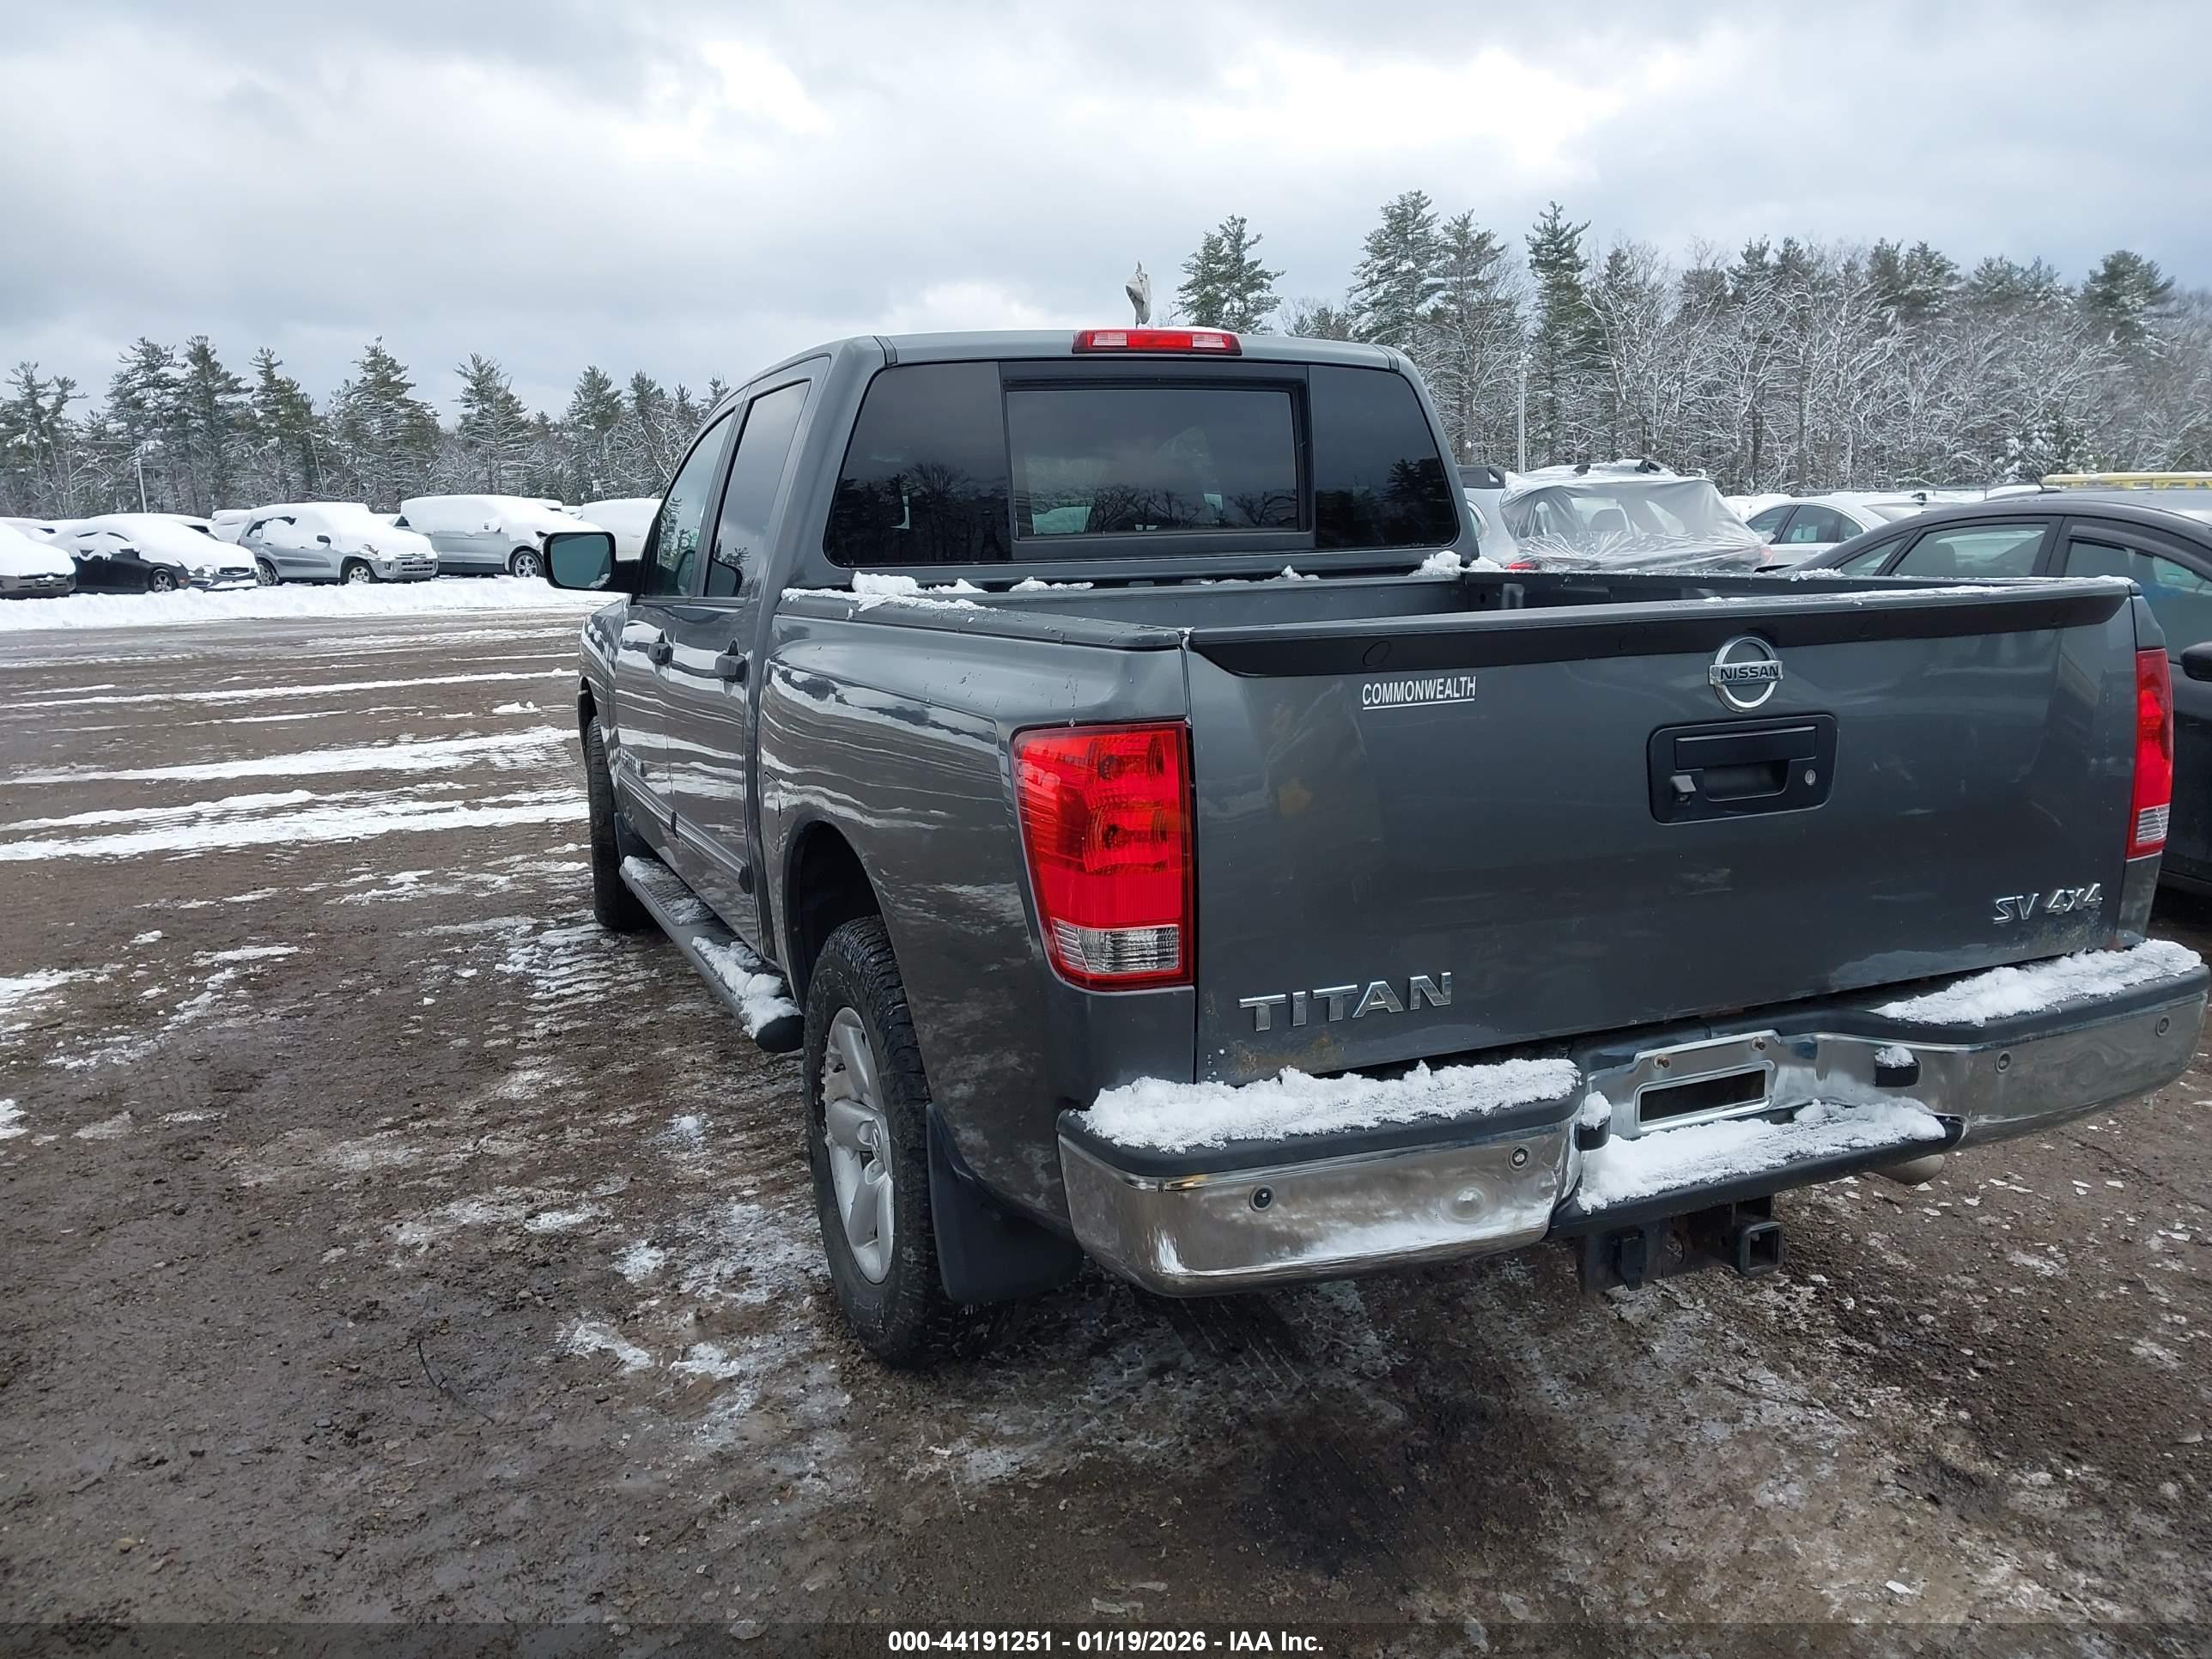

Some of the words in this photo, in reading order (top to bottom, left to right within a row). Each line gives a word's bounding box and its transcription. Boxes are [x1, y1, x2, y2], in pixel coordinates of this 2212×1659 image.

[1720, 665, 1779, 680] NISSAN
[1362, 676, 1476, 705] COMMONWEALTH
[1992, 893, 2040, 924] SV
[1239, 972, 1452, 1032] TITAN
